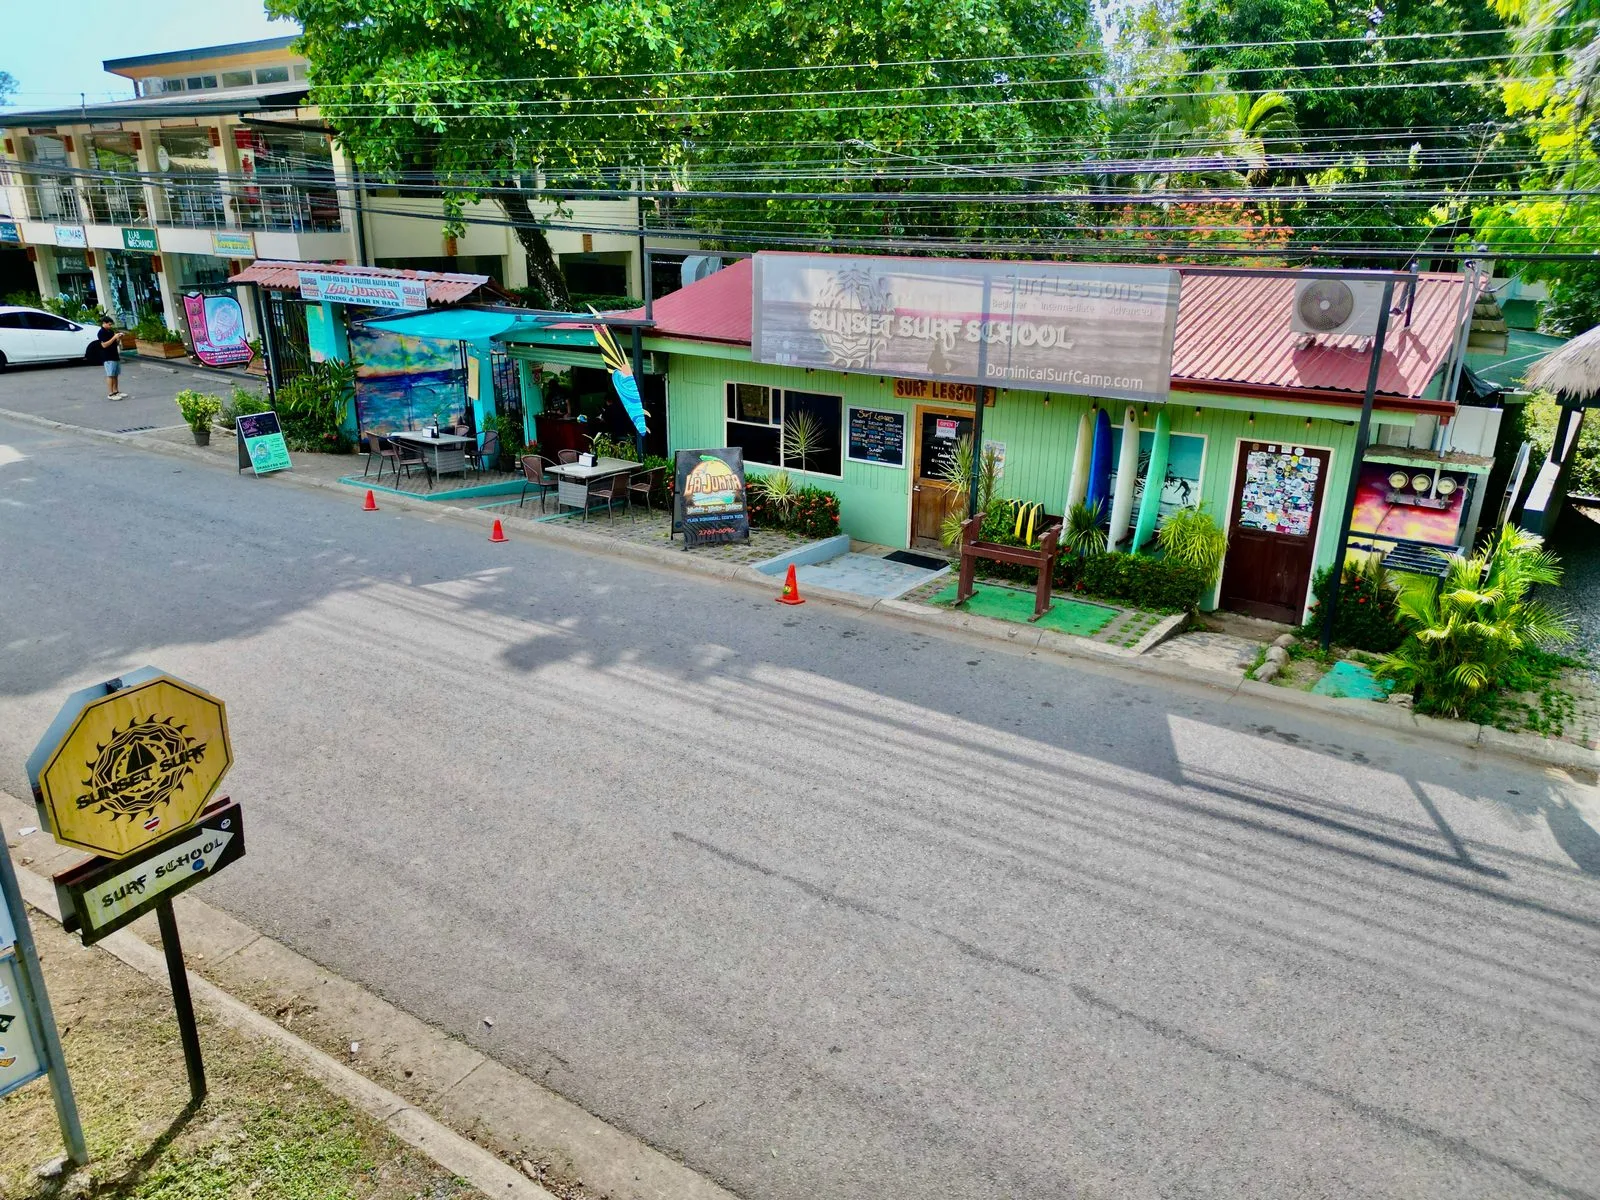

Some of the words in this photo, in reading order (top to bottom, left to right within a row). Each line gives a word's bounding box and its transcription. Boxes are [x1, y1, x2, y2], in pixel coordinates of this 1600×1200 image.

[326, 283, 347, 295] LA
[347, 285, 398, 300] JUNTA
[1004, 274, 1047, 296] Surf
[1055, 275, 1144, 301] Lessons
[1040, 302, 1095, 314] Intermediate
[809, 309, 896, 340] SUNSET
[898, 314, 963, 352] SURF
[965, 319, 1075, 350] SCHOOL
[986, 363, 1144, 390] DominicalSurfCamp.com
[897, 380, 928, 397] SURF
[932, 381, 990, 403] LESSOS
[684, 474, 701, 497] LA
[702, 473, 742, 494] JUNTA
[76, 766, 152, 810] SUNSET
[159, 742, 208, 774] SURF
[101, 874, 148, 908] SURF
[154, 838, 223, 879] SCHOOL
